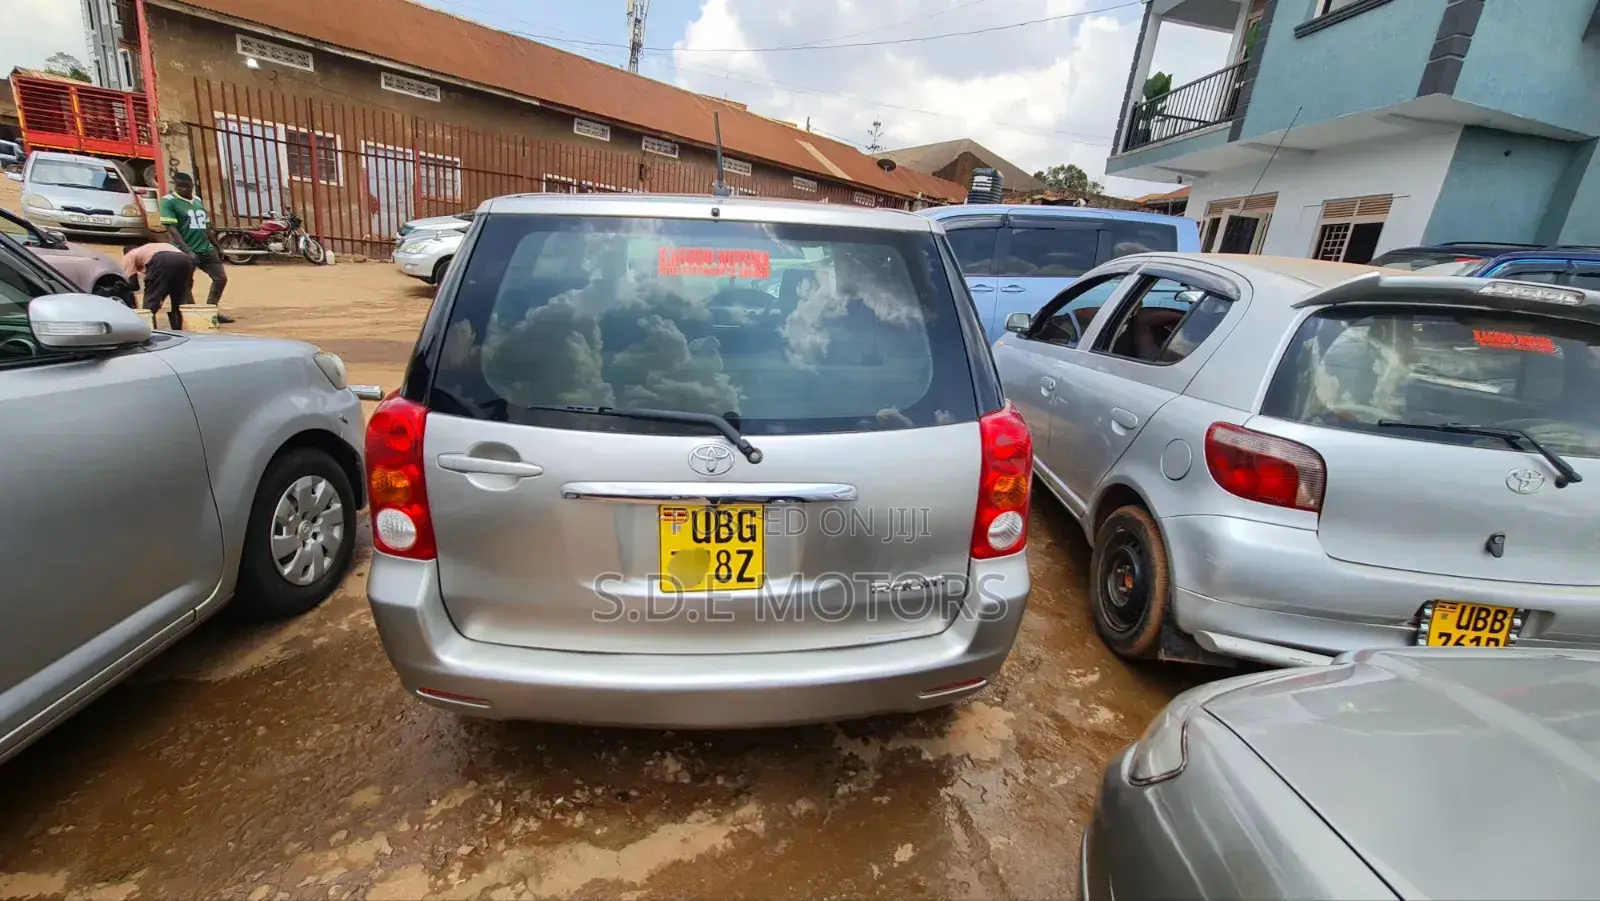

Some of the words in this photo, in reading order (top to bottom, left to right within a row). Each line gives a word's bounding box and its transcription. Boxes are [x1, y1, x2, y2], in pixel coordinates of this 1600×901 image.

[187, 209, 207, 230] 12
[691, 510, 757, 544] UBG
[1455, 605, 1508, 634] UBB
